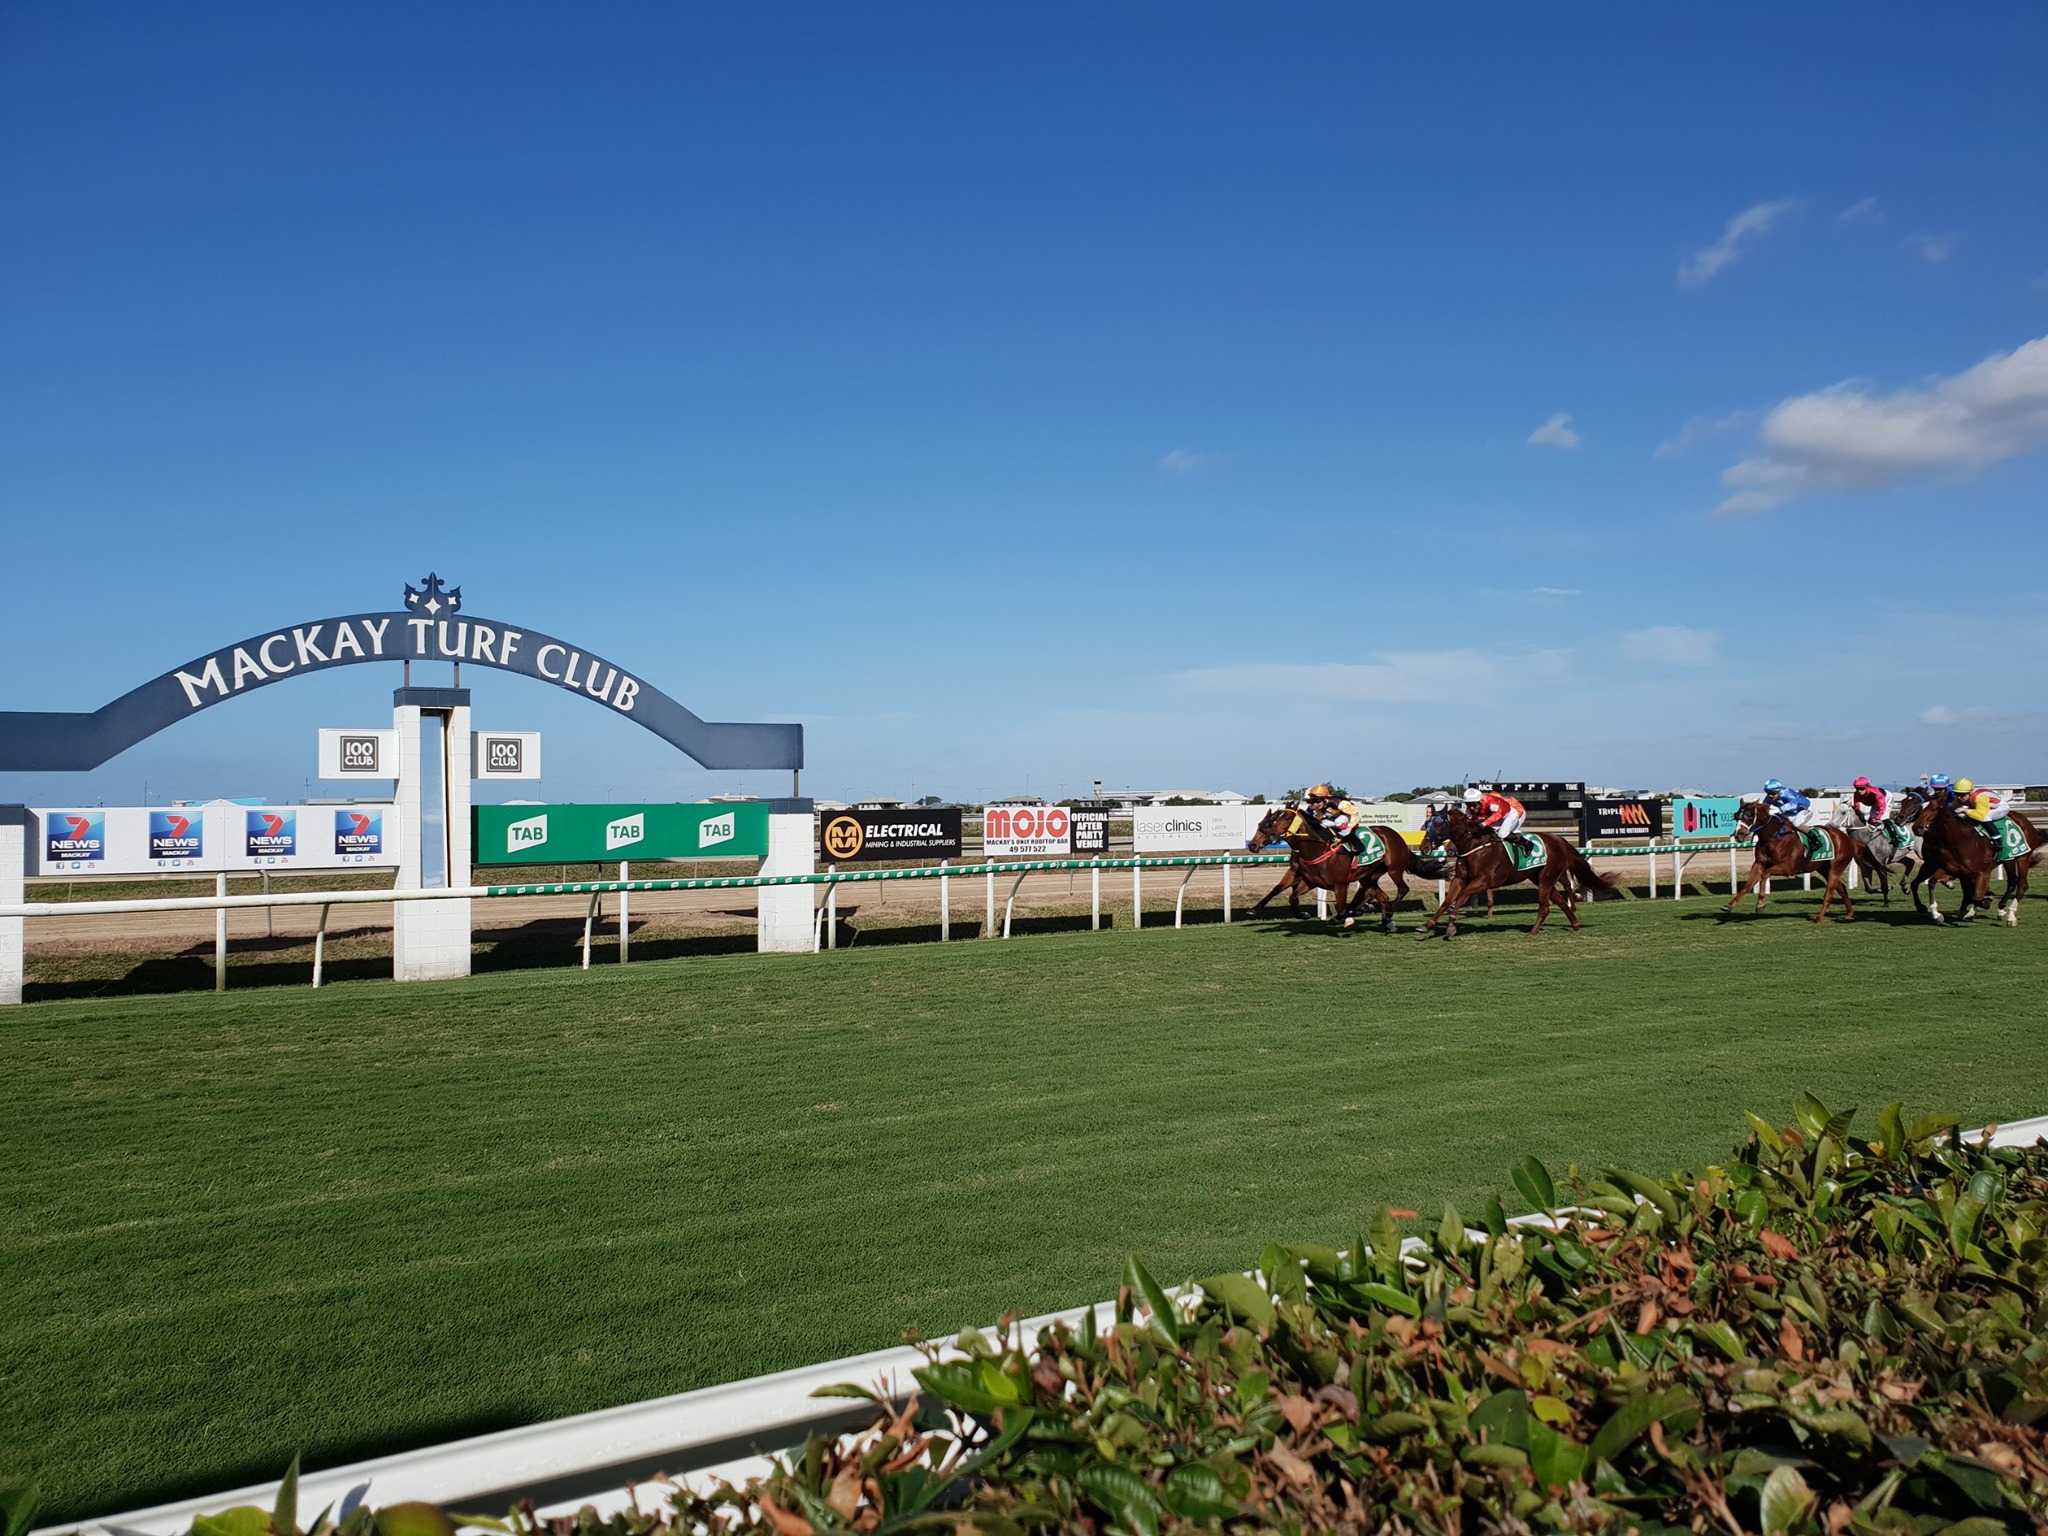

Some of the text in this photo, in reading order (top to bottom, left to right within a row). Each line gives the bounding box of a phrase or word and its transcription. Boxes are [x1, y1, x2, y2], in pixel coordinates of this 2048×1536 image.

[174, 618, 640, 711] MACKAY TURF CLUB
[346, 742, 373, 756] 100
[492, 744, 517, 757] 100
[345, 756, 374, 766] CLUB
[491, 757, 517, 766] CLUB
[1071, 812, 1108, 822] OFFICIAL
[1598, 808, 1624, 816] TRIPLE
[986, 809, 1068, 838] MOJO
[1700, 808, 1718, 829] hit
[703, 824, 731, 837] TAB
[865, 824, 943, 838] ELECTRICAL
[1076, 821, 1103, 831] AFTER
[512, 827, 544, 840] TAB
[610, 825, 640, 838] TAB
[1075, 830, 1103, 839] PARTY
[2005, 820, 2022, 847] 6
[153, 838, 199, 847] NEWS
[250, 836, 292, 845] NEWS
[338, 835, 378, 843] NEWS
[865, 840, 888, 848] MINING
[896, 840, 927, 848] INDUSTRIAL
[1076, 839, 1103, 849] VENUE
[1359, 831, 1381, 854] 2
[51, 840, 99, 849] NEWS
